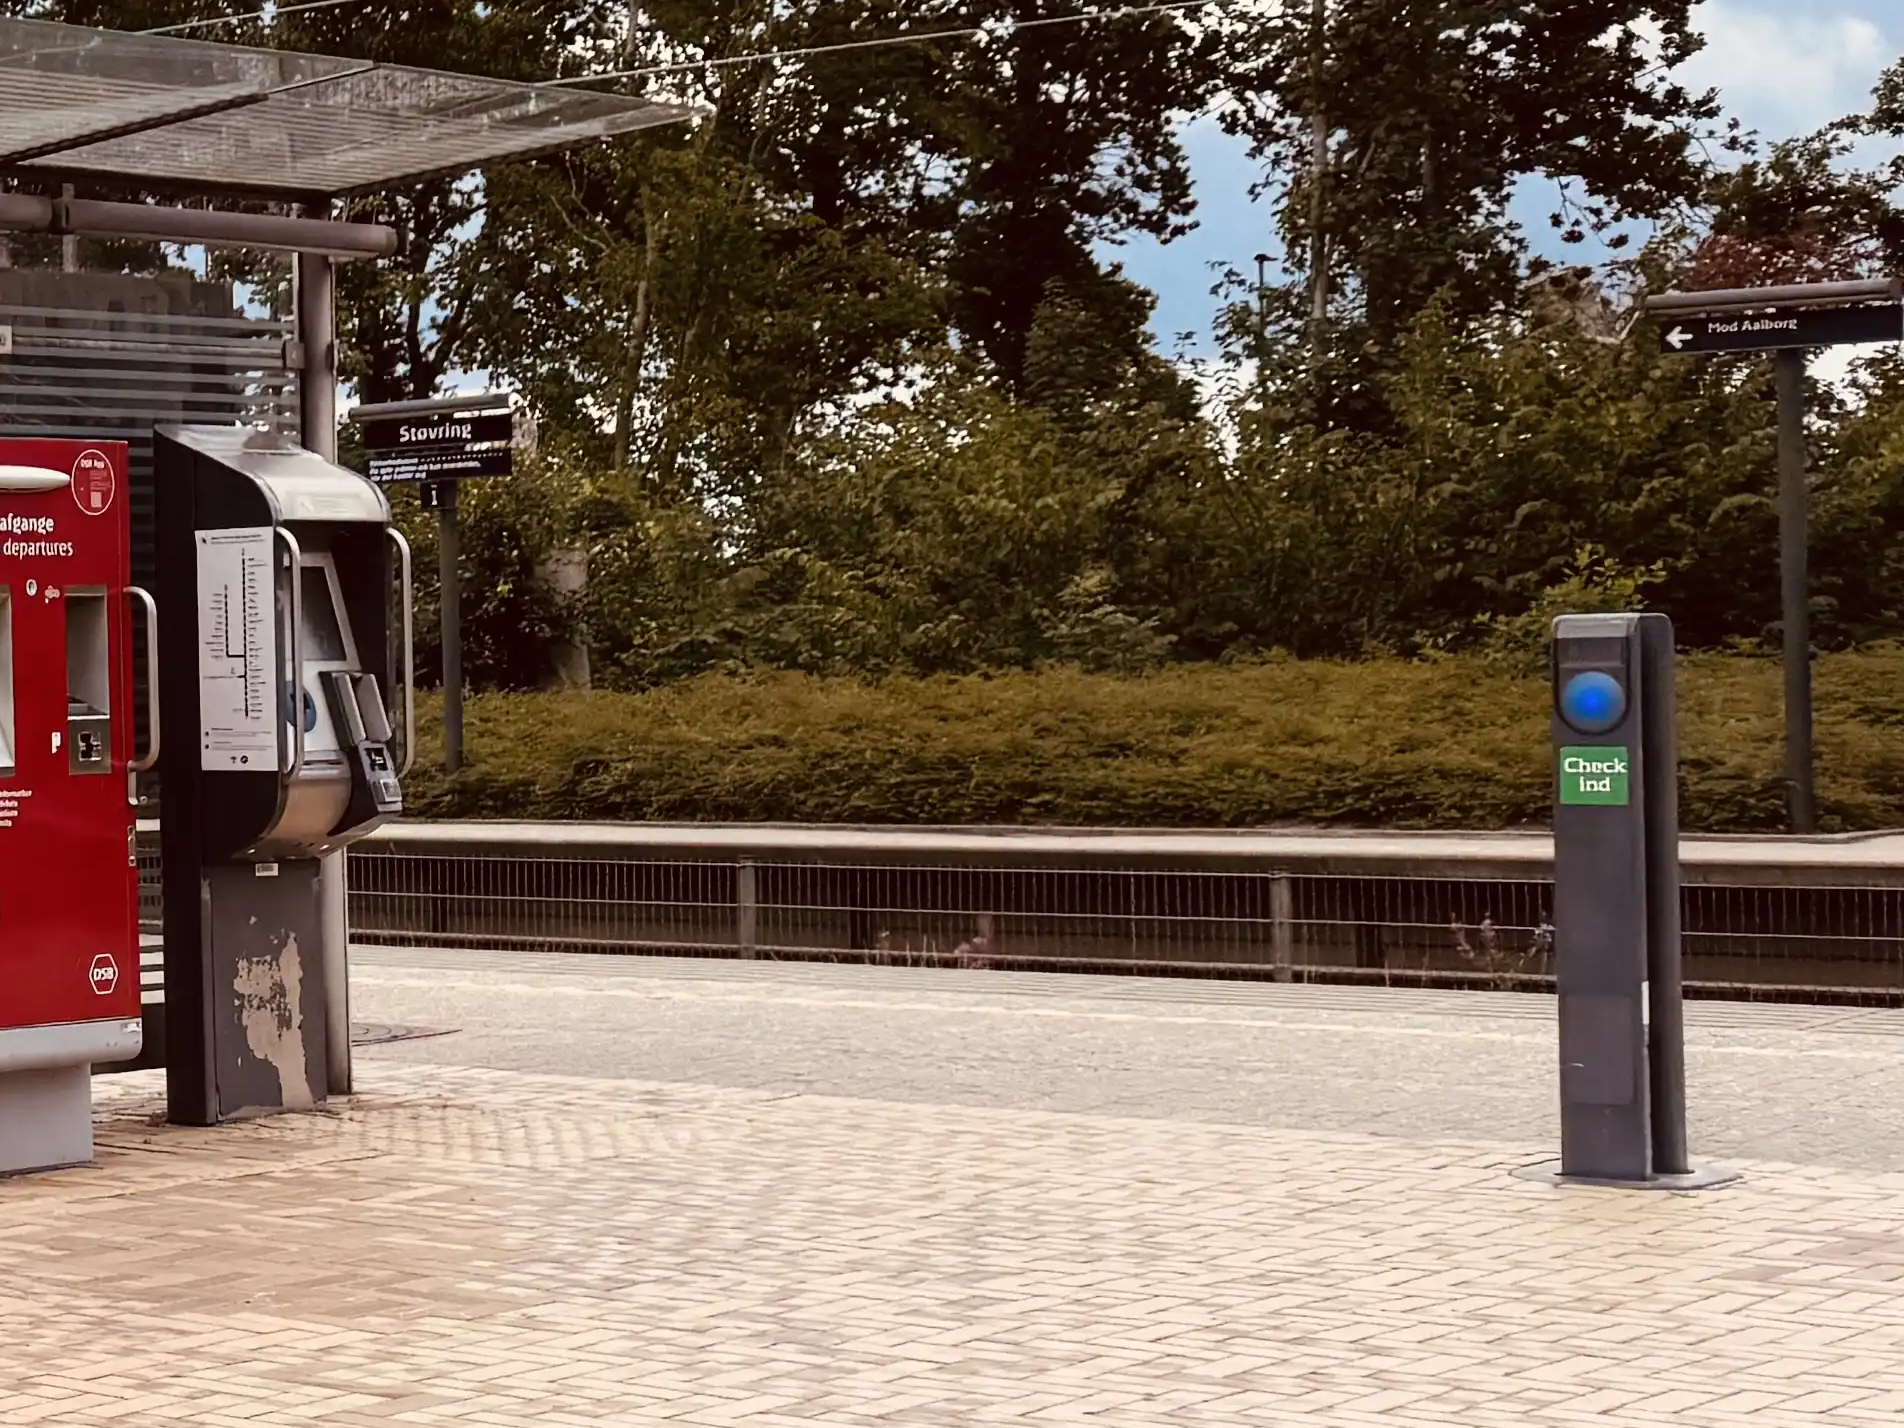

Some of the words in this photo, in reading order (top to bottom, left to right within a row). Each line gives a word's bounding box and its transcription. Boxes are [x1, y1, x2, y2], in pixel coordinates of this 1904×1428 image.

[1708, 321, 1738, 333] Mod
[1741, 318, 1798, 331] Aalborg
[399, 422, 472, 443] Støvring
[2, 537, 74, 560] departures
[1564, 757, 1629, 774] Check
[93, 967, 114, 981] DSB
